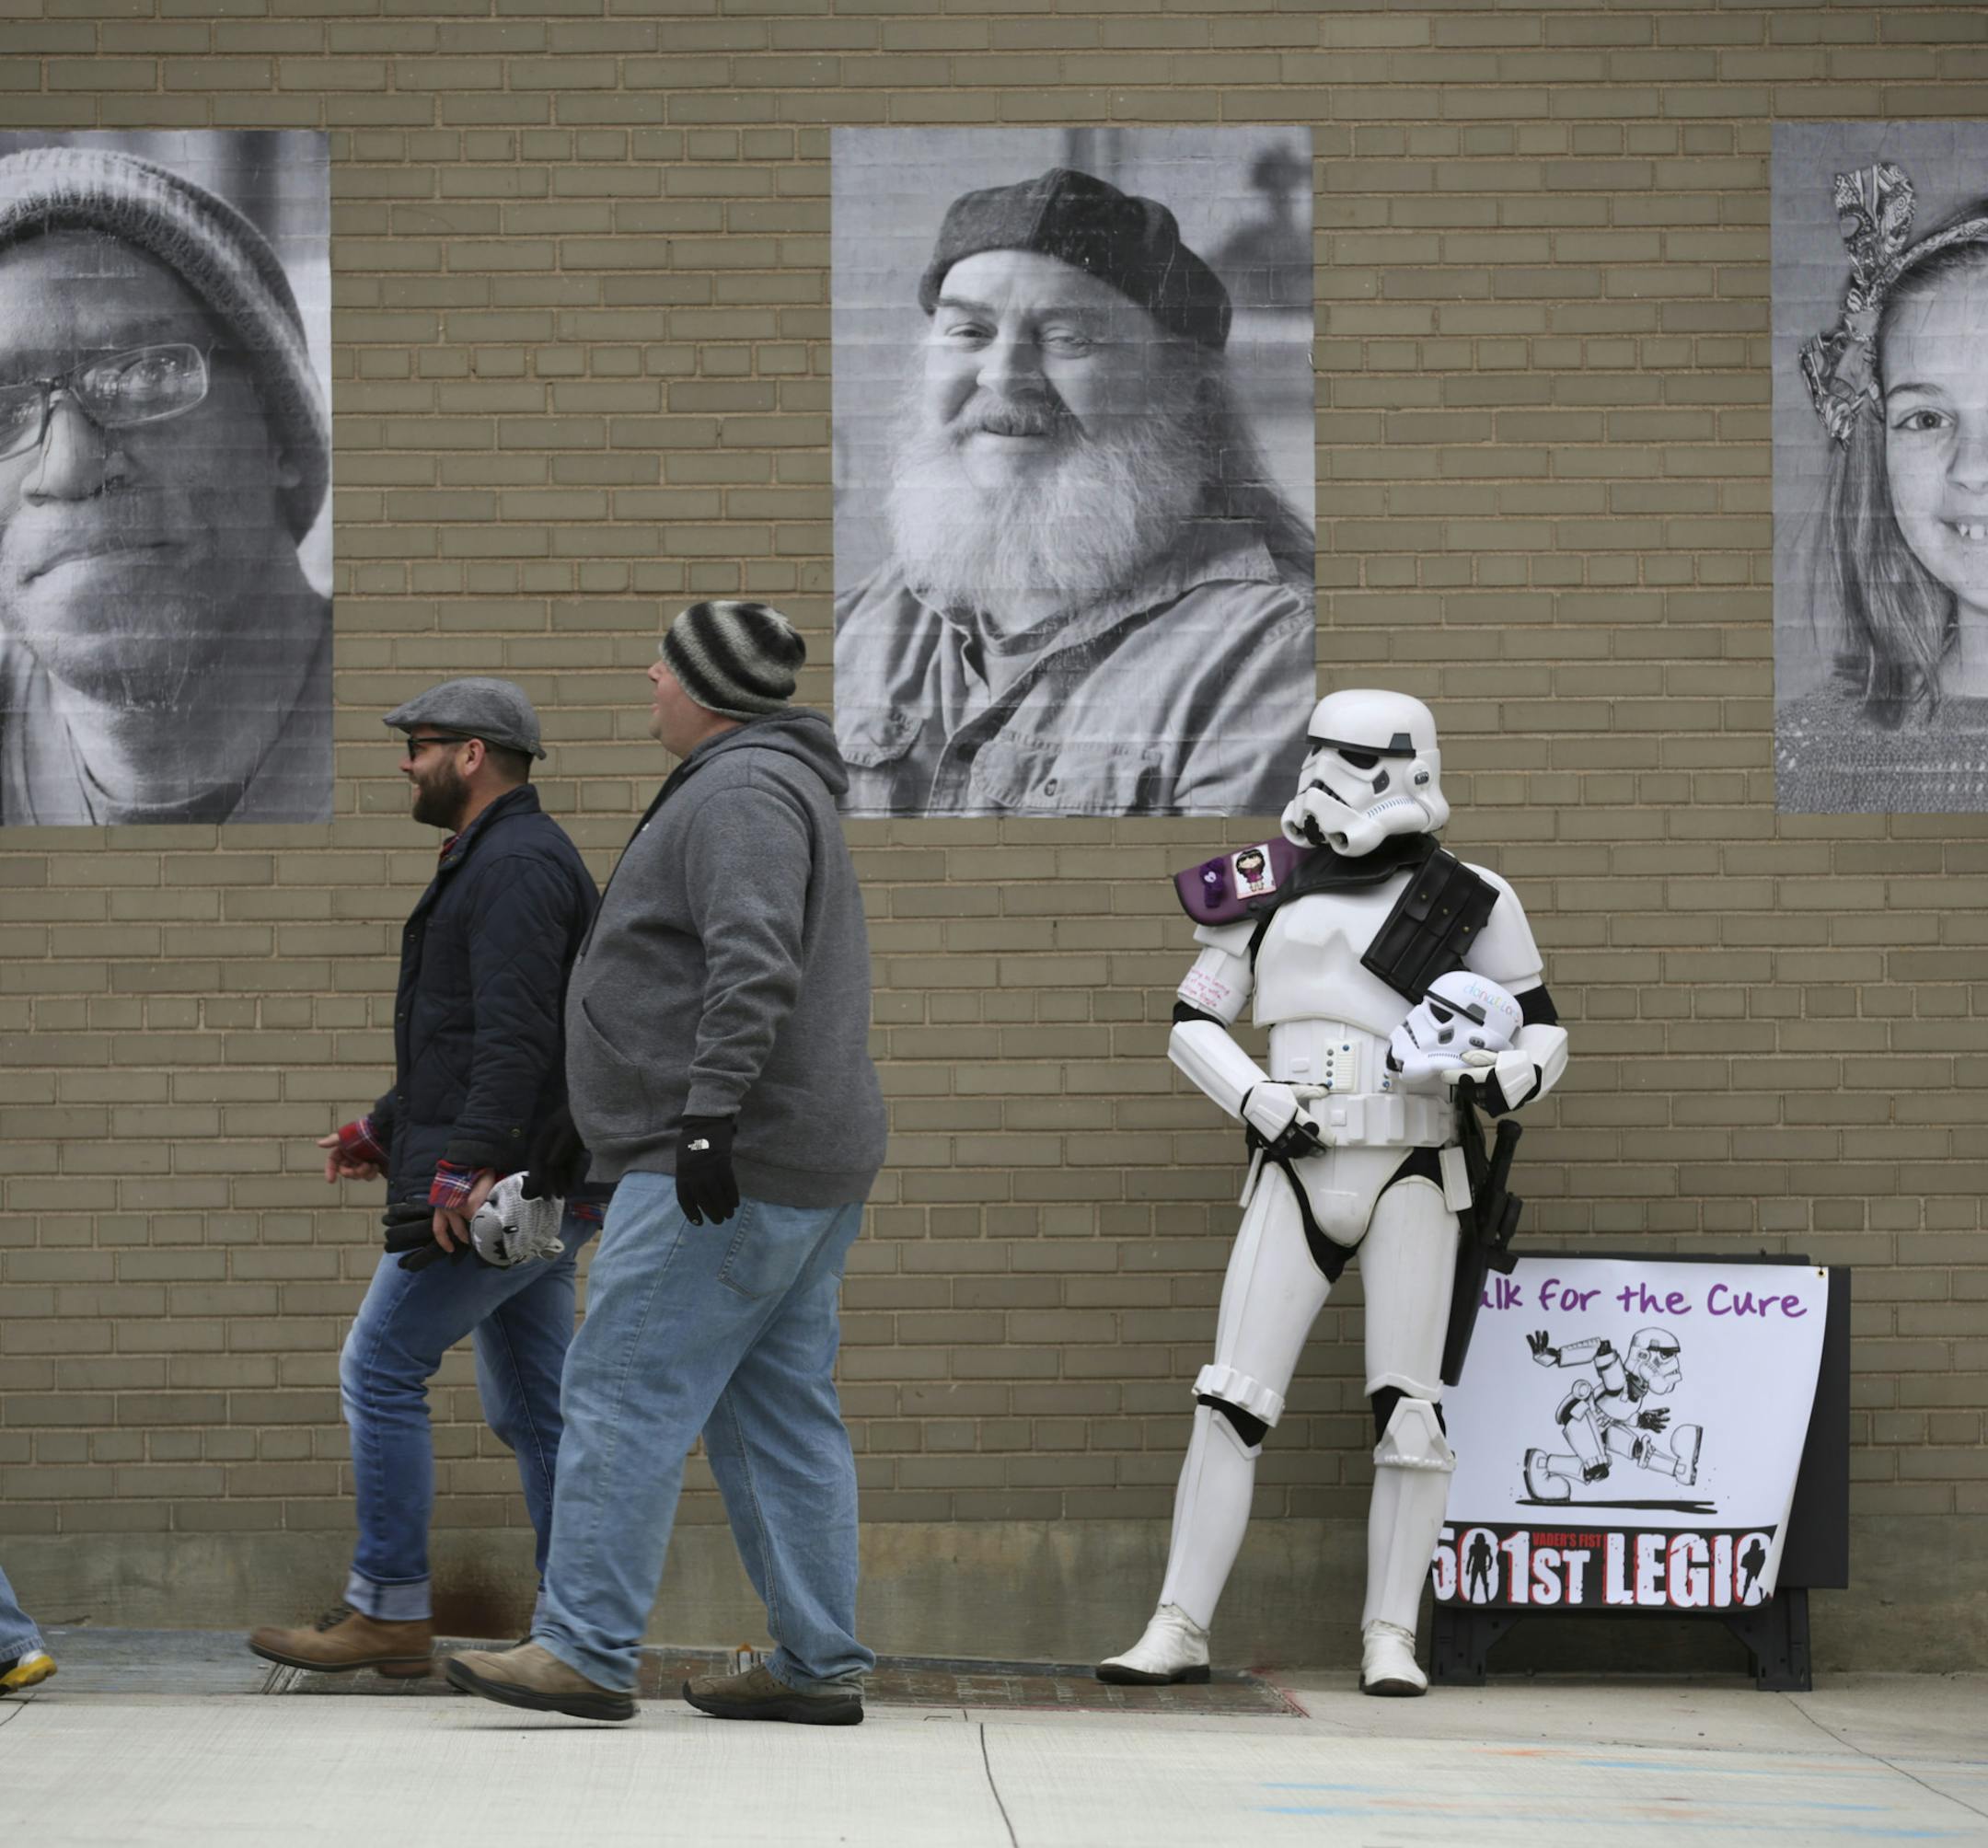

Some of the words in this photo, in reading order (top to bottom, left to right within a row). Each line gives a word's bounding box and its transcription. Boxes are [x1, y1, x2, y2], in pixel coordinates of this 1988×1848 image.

[1616, 1283, 1692, 1315] the
[1707, 1284, 1808, 1318] Cure
[1532, 1531, 1577, 1547] VADER'S
[1579, 1532, 1601, 1547] FIST
[1603, 1531, 1774, 1608] LEGIO
